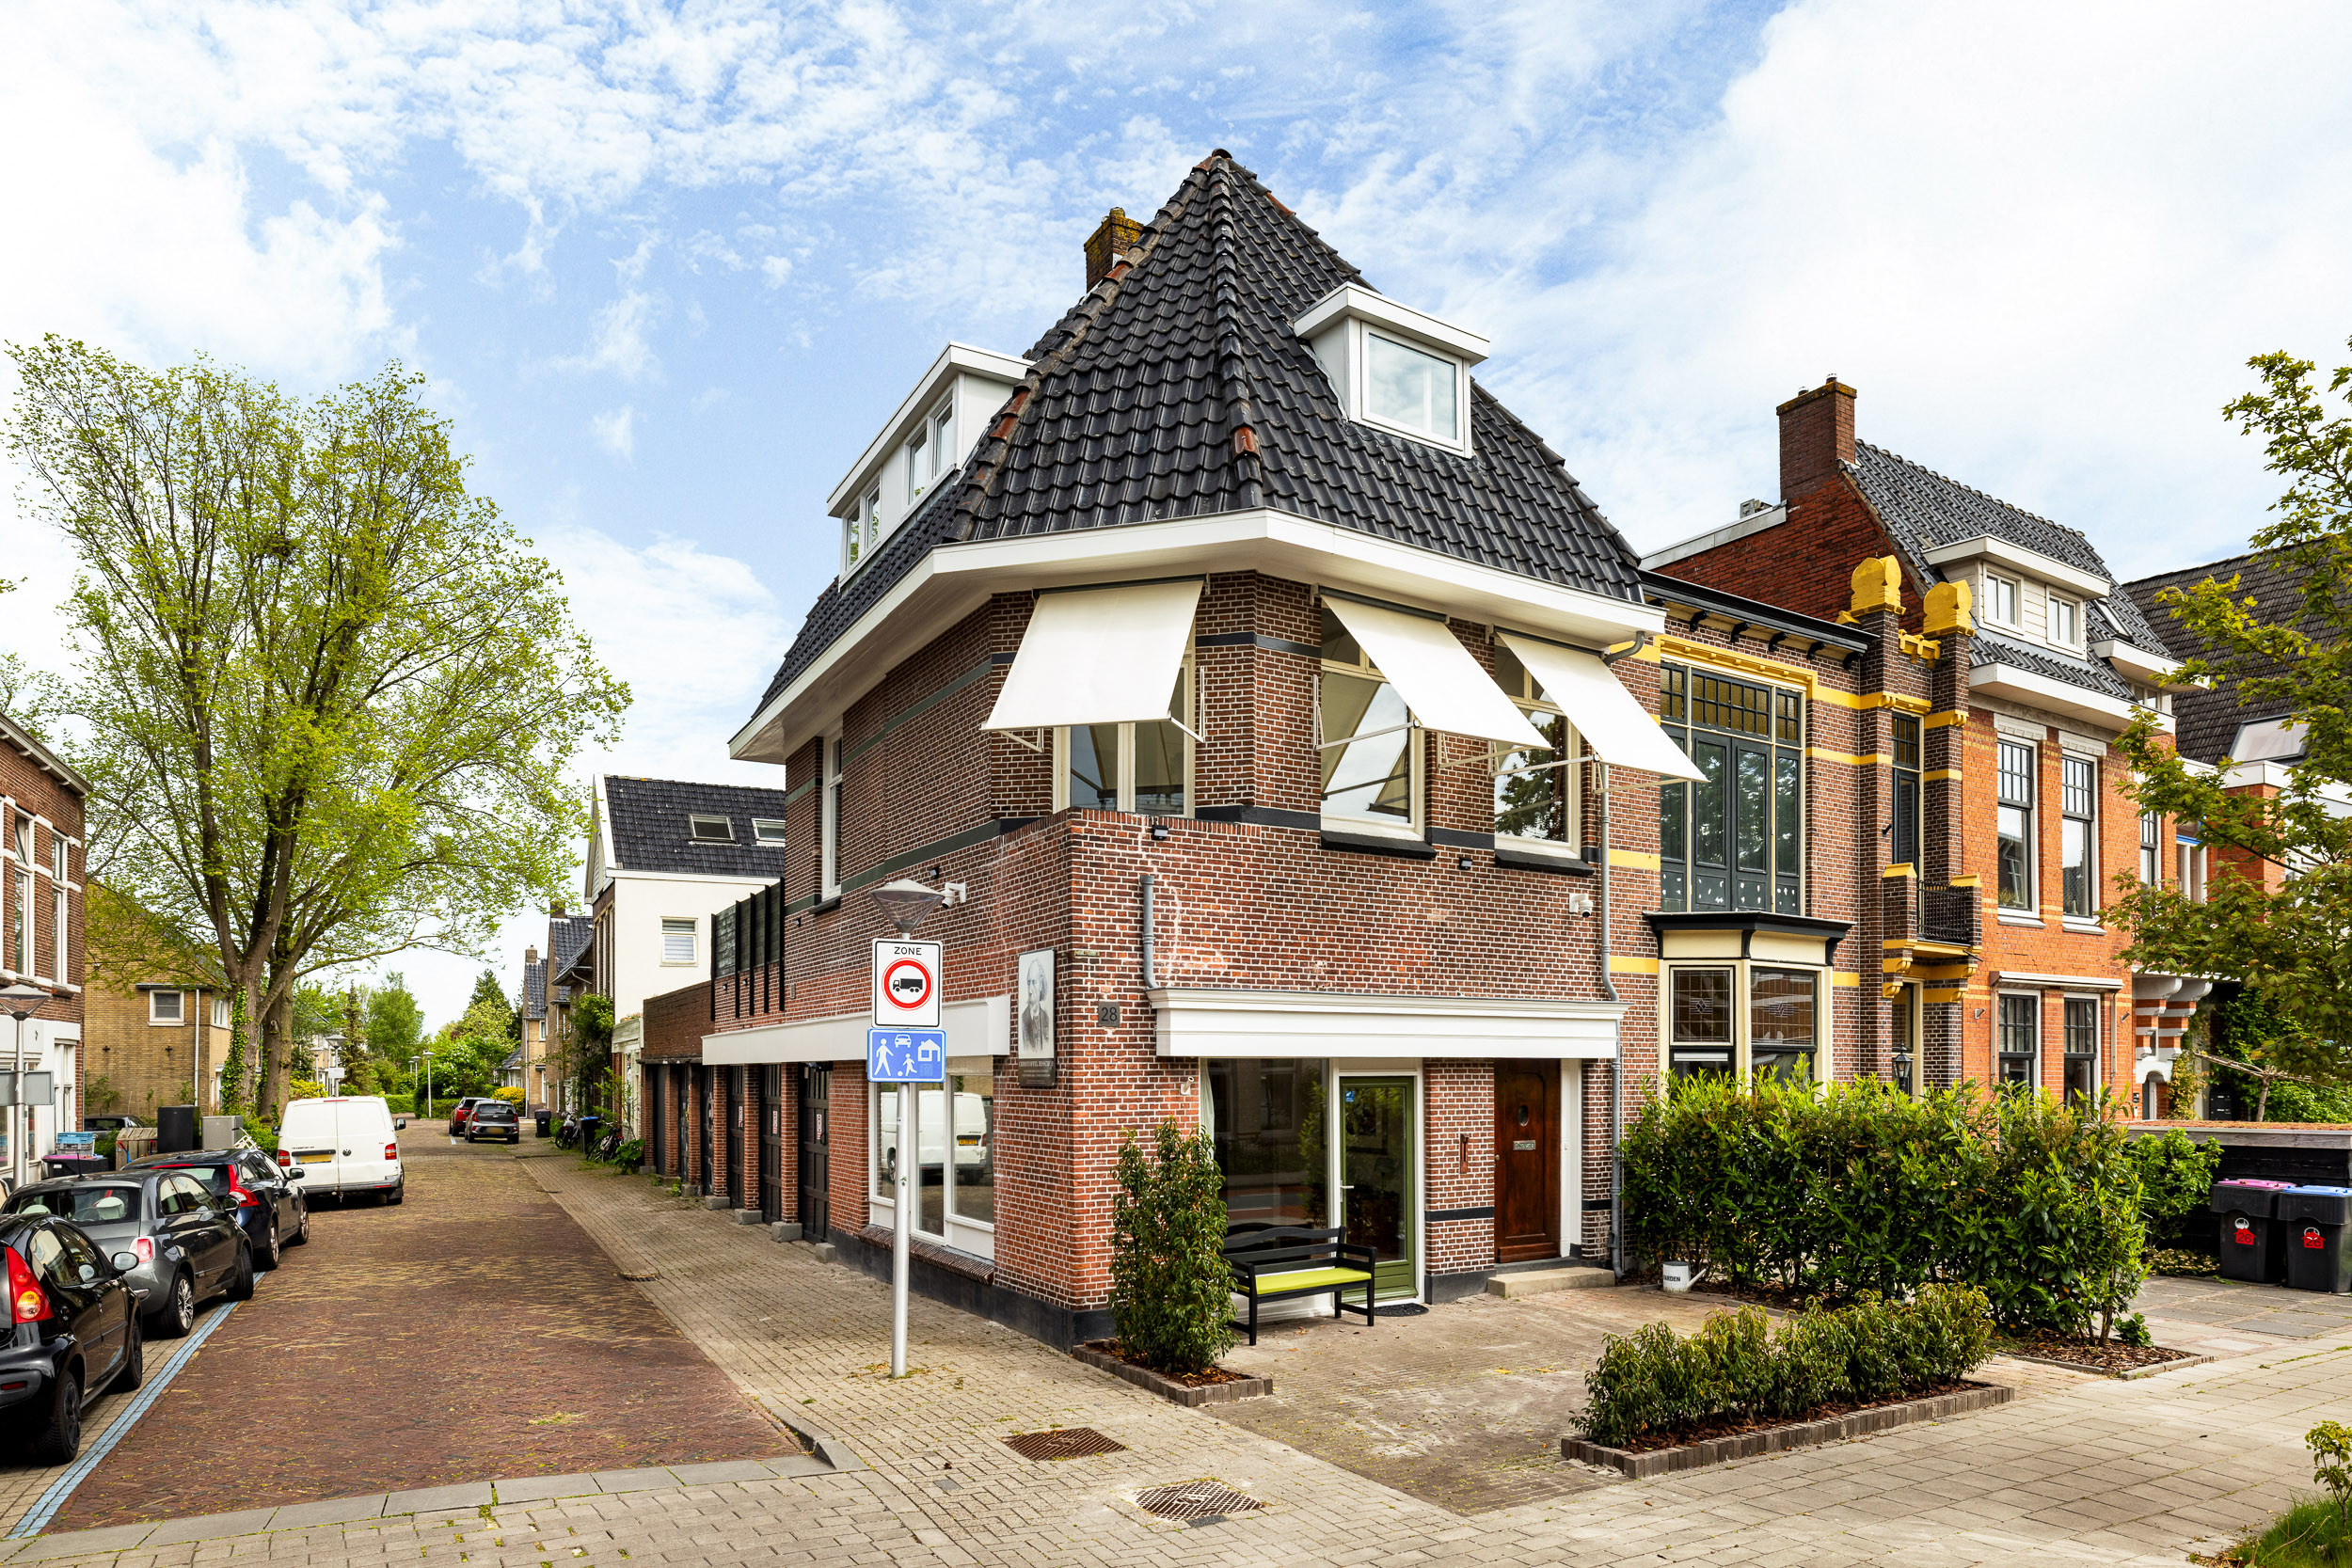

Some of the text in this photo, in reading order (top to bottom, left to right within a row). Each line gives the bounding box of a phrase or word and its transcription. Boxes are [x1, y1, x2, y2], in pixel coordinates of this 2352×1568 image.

[894, 946, 922, 956] ZONE
[1101, 1006, 1118, 1022] 28
[2236, 1232, 2252, 1243] 26
[2305, 1236, 2321, 1247] 26
